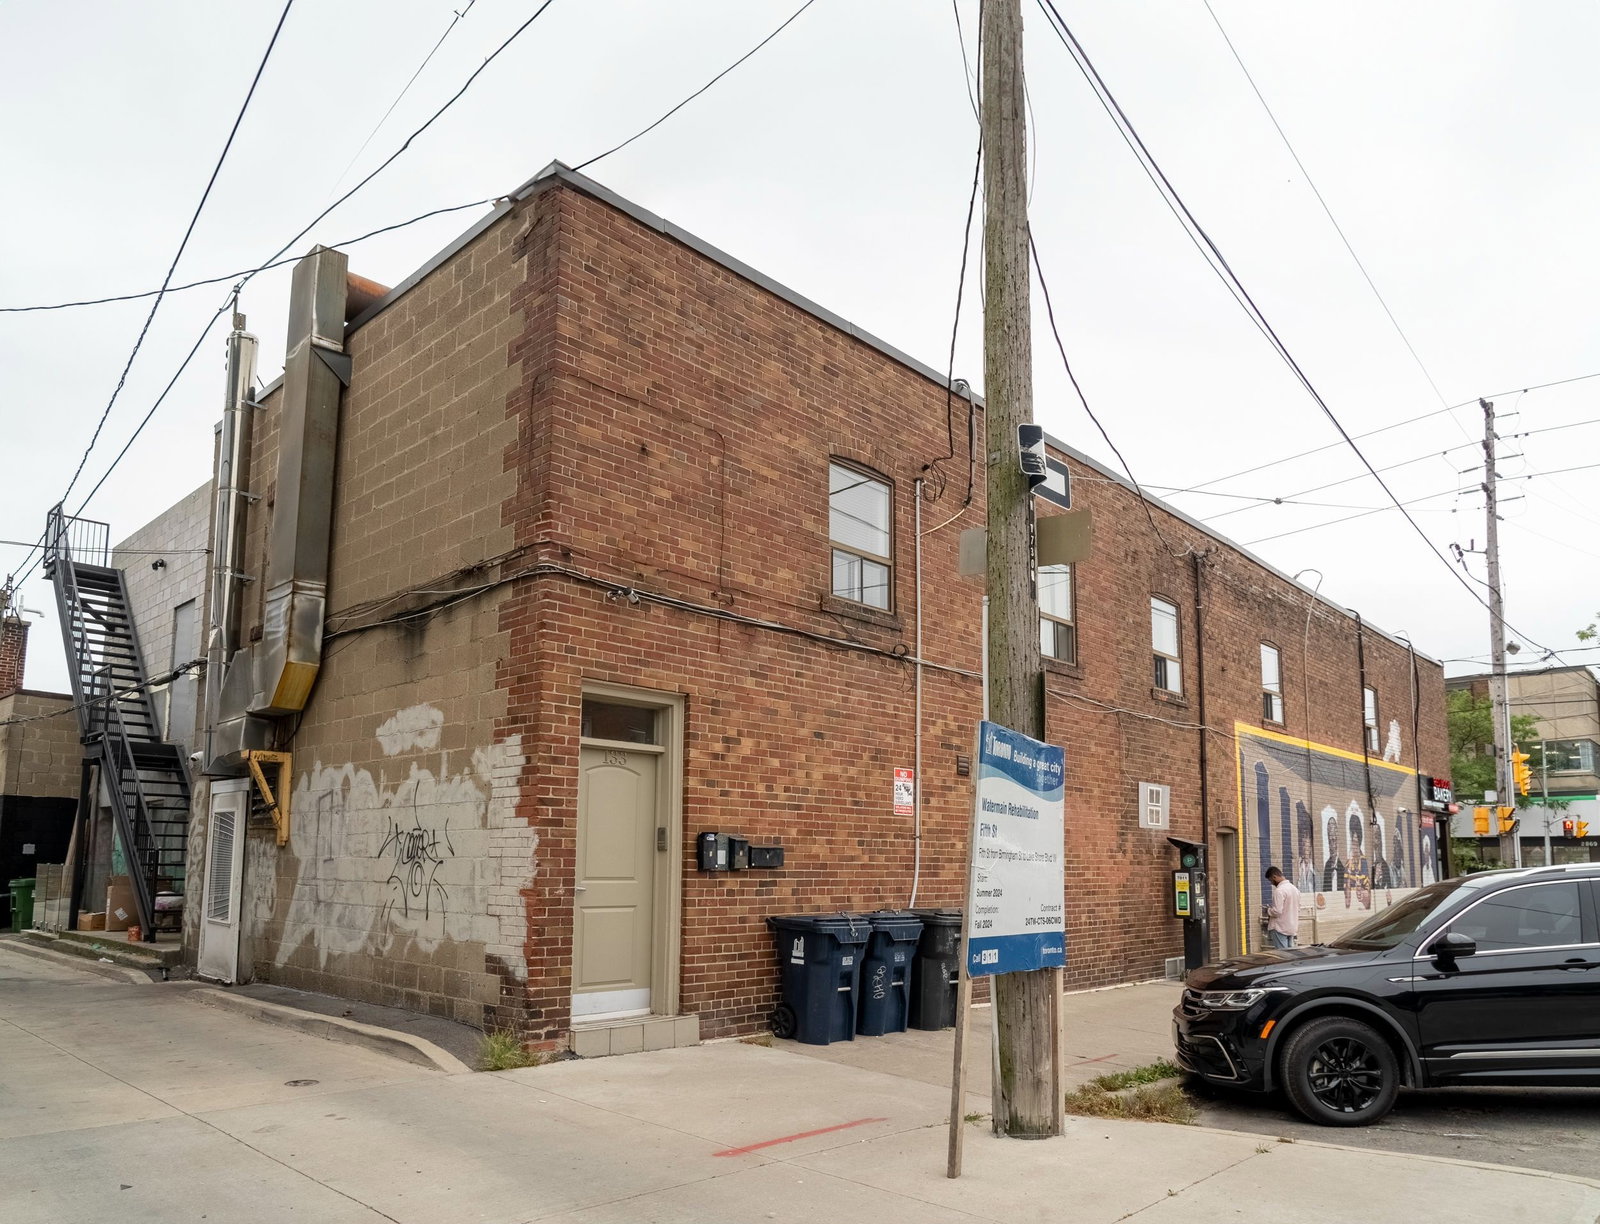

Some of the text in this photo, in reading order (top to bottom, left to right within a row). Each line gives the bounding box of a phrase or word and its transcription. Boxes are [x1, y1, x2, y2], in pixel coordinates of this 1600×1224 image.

[602, 750, 627, 766] 133
[1014, 750, 1032, 769] Building
[1037, 760, 1050, 771] great
[1050, 761, 1062, 776] city
[1434, 786, 1452, 802] BAKERY
[982, 797, 1039, 820] Watermain Rehabilitation
[992, 824, 998, 838] St
[976, 888, 1003, 898] Summer 2024
[975, 903, 999, 915] Completion:
[1040, 904, 1057, 912] Contract
[982, 919, 993, 928] 2024
